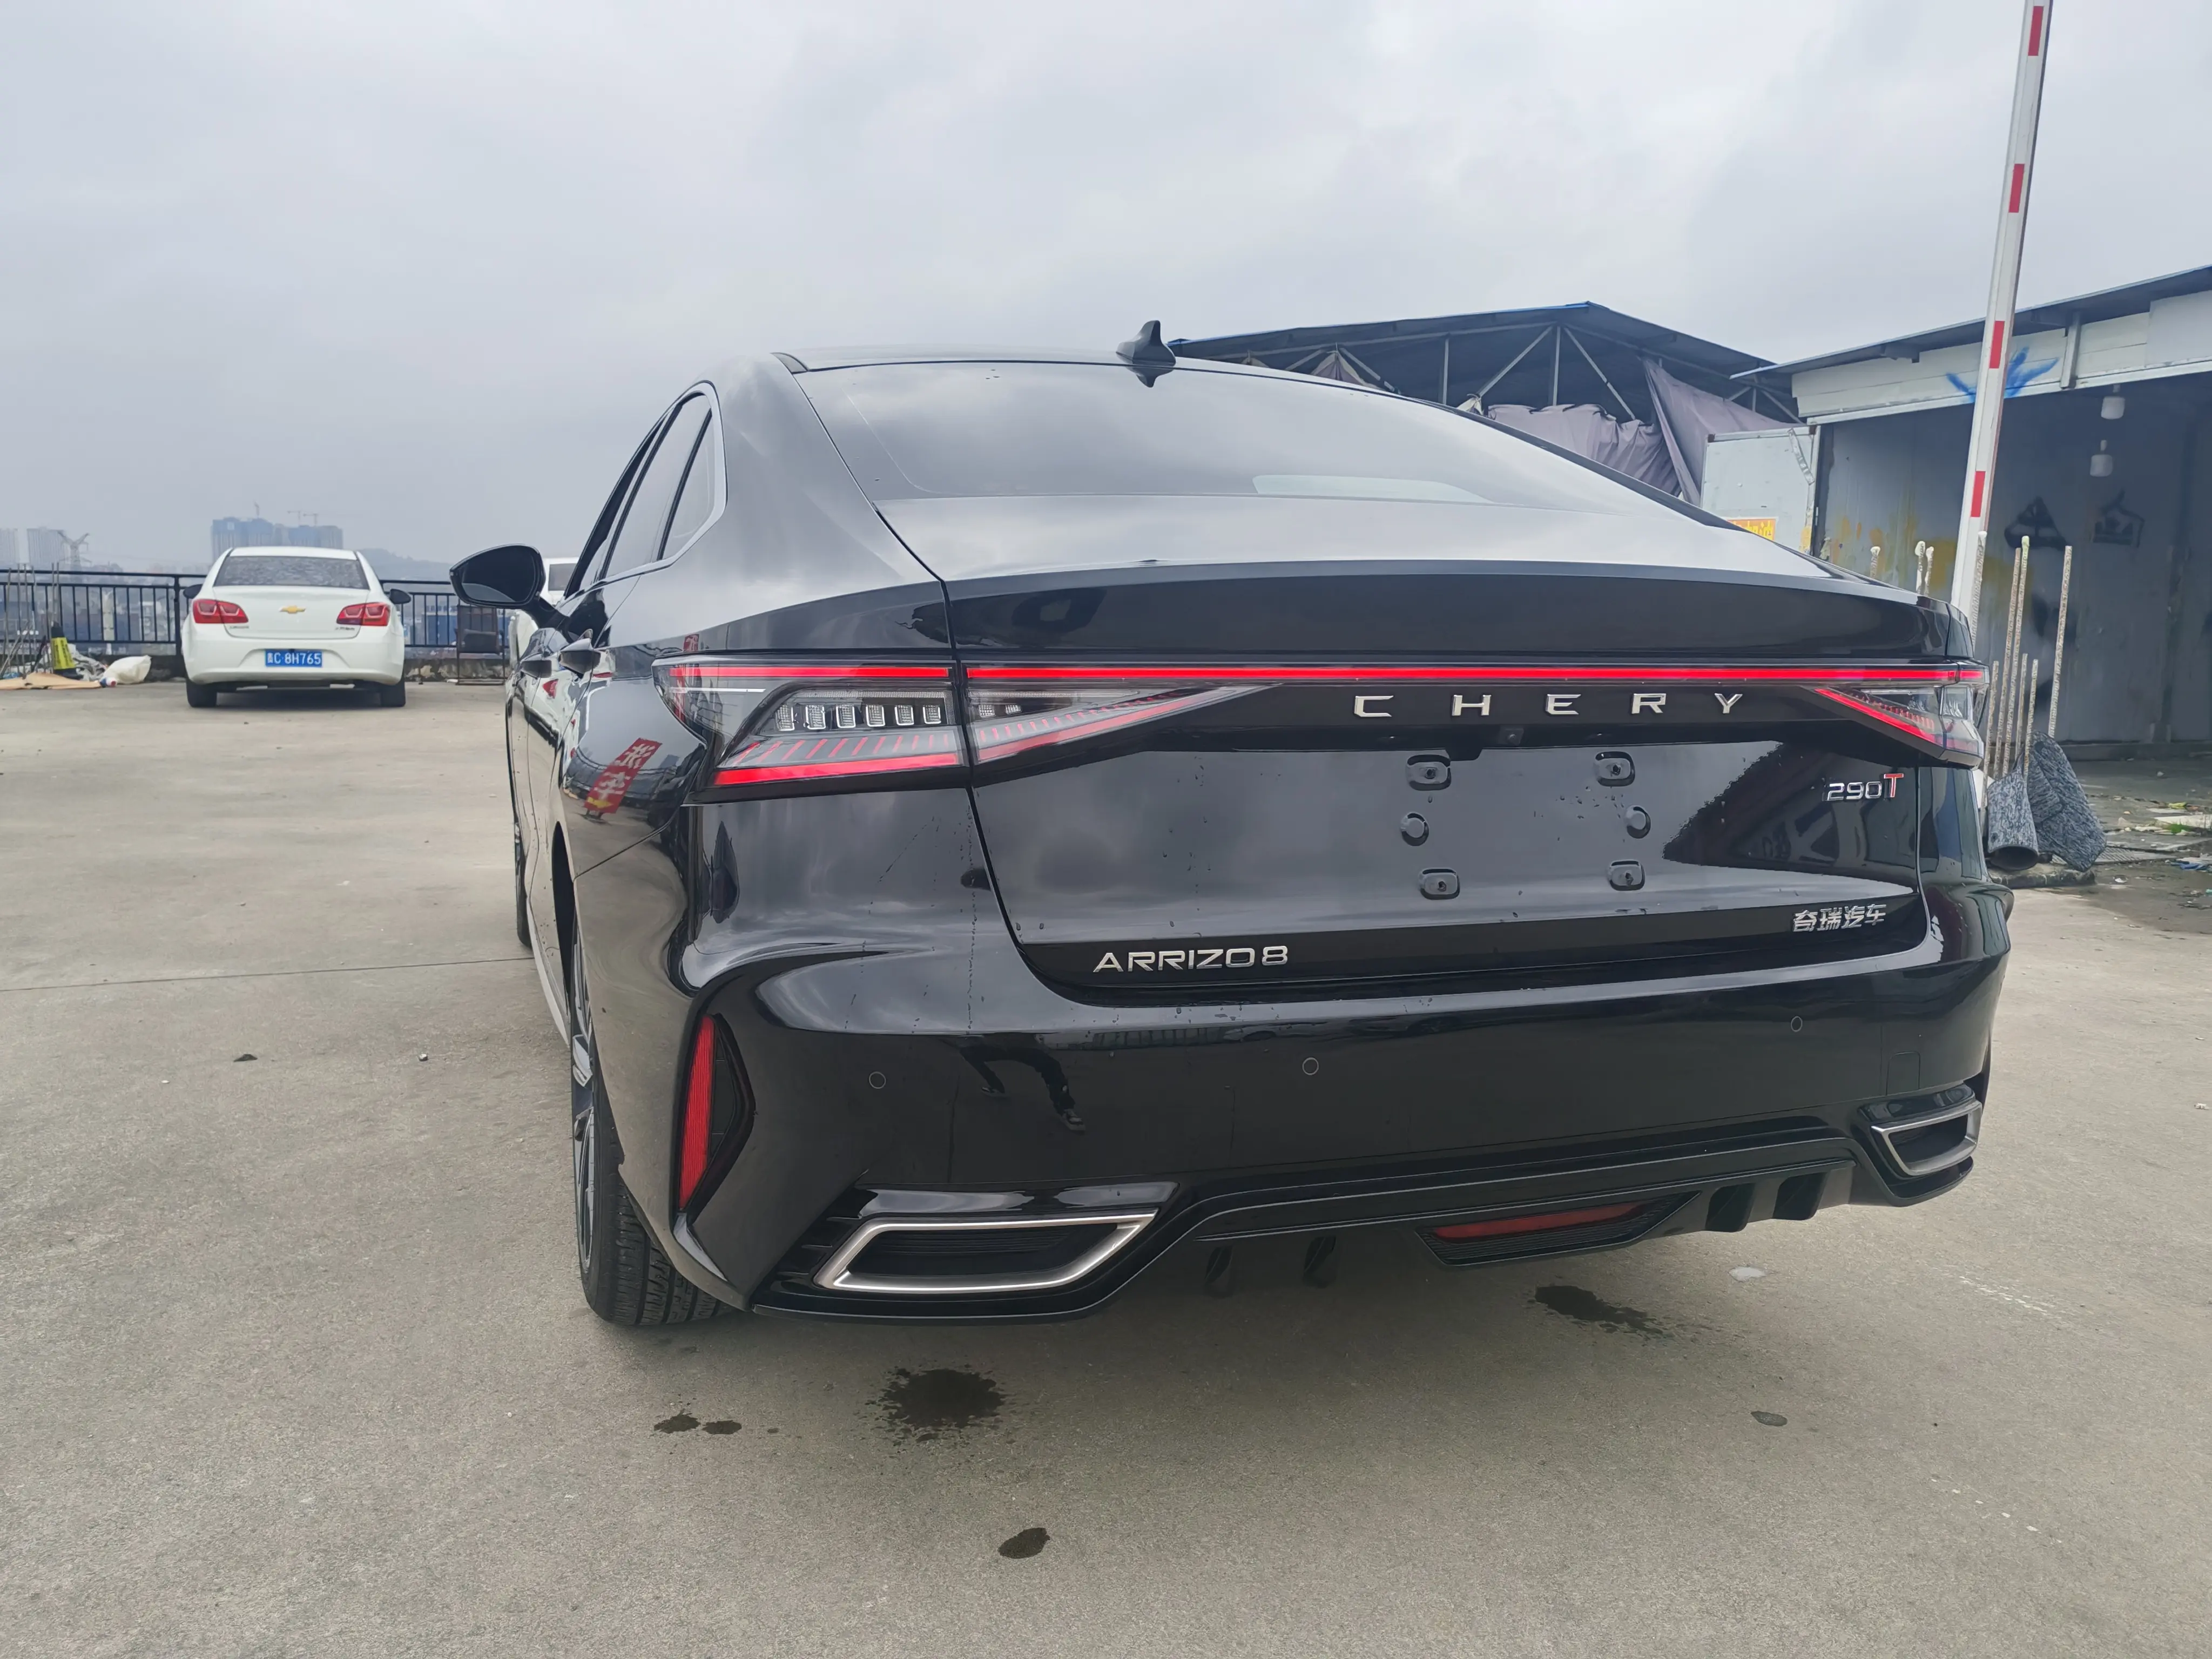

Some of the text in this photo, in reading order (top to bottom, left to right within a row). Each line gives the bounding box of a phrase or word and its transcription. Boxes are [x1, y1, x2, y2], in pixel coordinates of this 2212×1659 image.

[1354, 693, 1743, 717] CHERY
[1826, 773, 1904, 801] 290T
[1793, 903, 1886, 932] 奇瑞汽车
